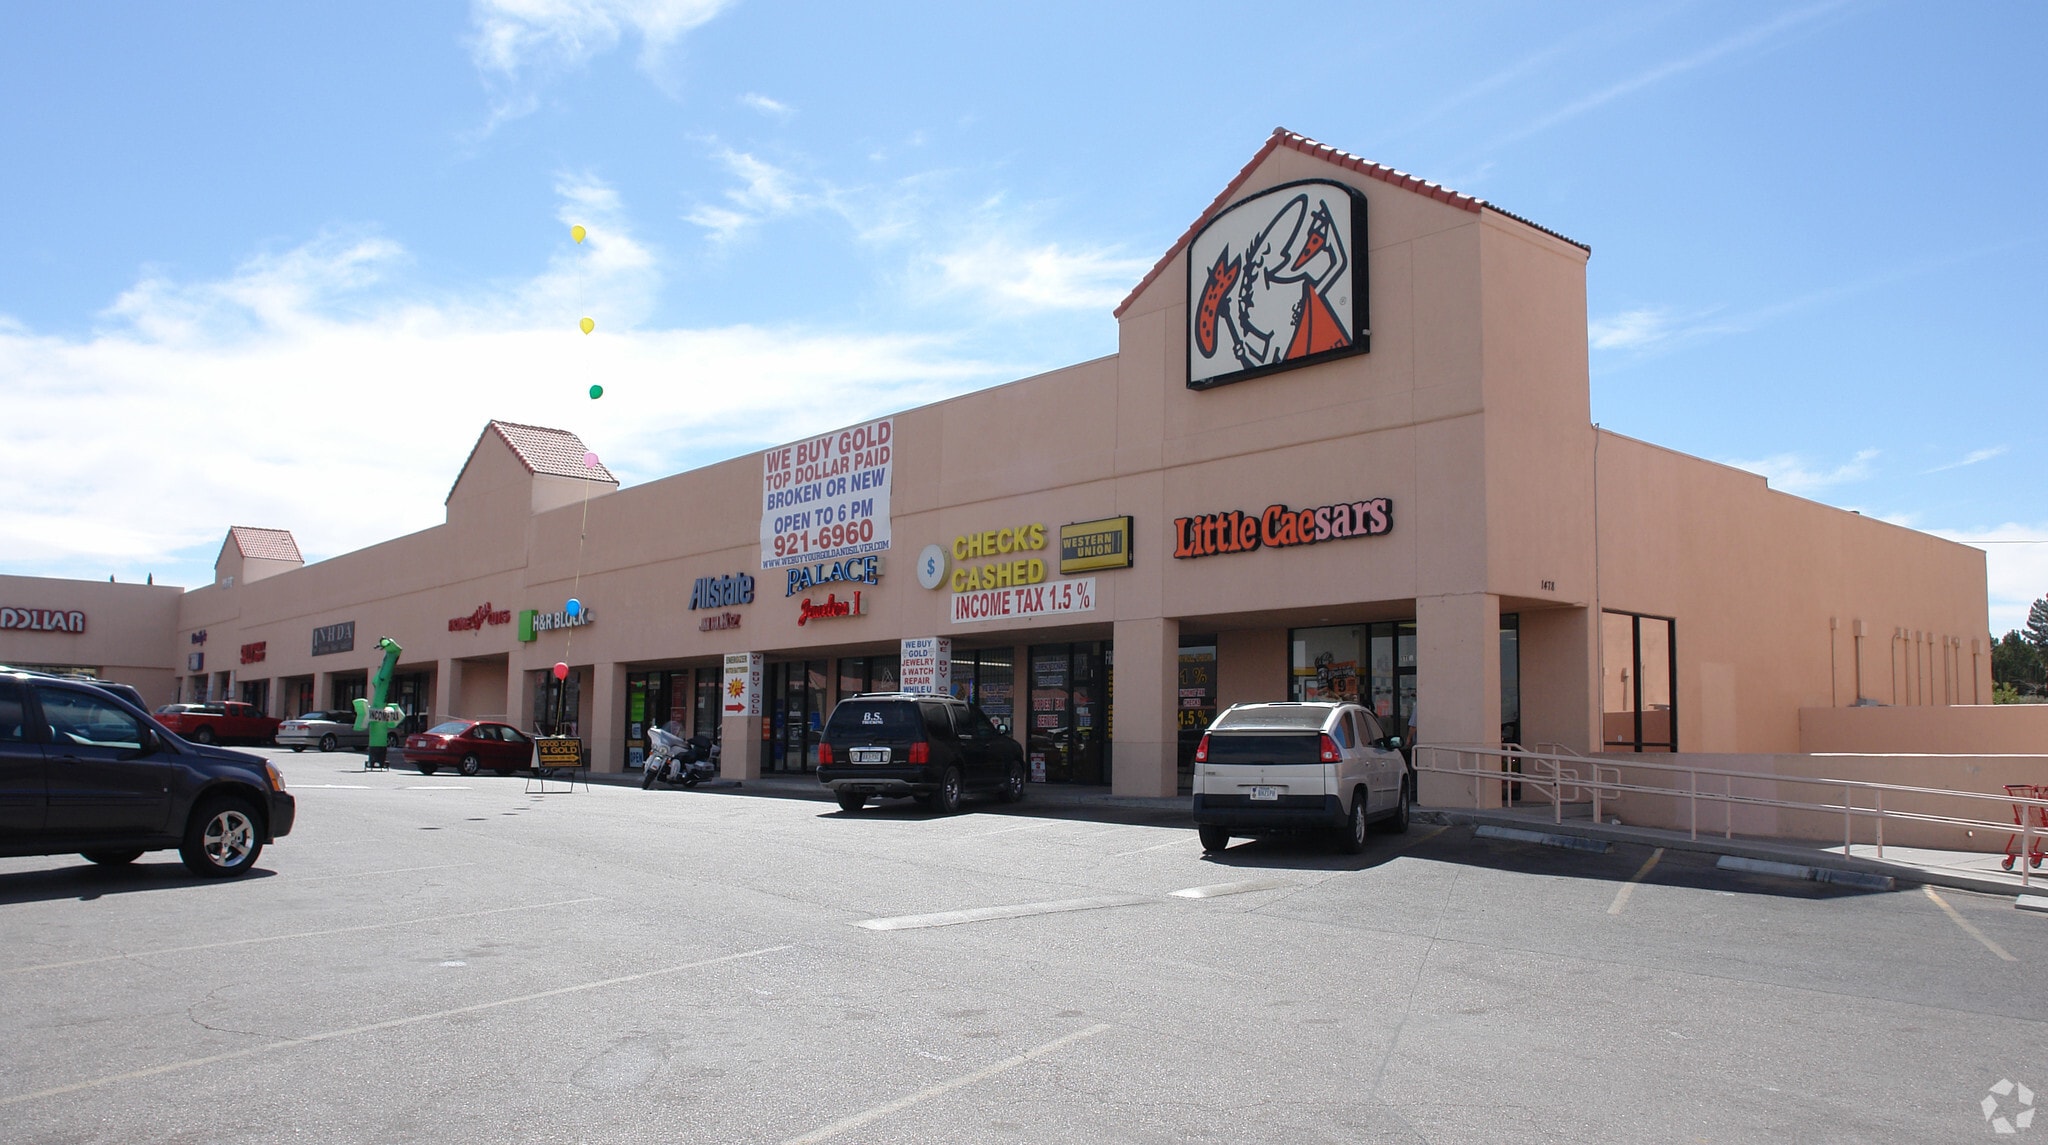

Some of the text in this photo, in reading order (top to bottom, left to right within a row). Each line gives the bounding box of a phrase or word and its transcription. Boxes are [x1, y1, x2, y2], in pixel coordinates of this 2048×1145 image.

[767, 421, 891, 473] WE BUY GOLD
[766, 446, 890, 491] TOP DOLLAR PAID
[767, 468, 885, 510] BROKEN OR NEW
[774, 498, 873, 534] OPEN TO 6 PM
[1174, 498, 1393, 559] Little Caesars
[774, 519, 873, 557] 921-6960
[952, 522, 1047, 560] CHECKS
[1063, 533, 1112, 549] WESTERN
[1077, 544, 1112, 557] UNION
[688, 572, 754, 610] Allstate
[785, 555, 878, 597] PALACE
[952, 558, 1046, 593] CASHED
[956, 581, 1090, 619] INCOME TAX 1.5 %
[0, 606, 84, 633] DOLLAR
[532, 613, 552, 631] H&R
[905, 640, 932, 648] WE BUY
[909, 649, 928, 657] GOLD
[902, 658, 934, 667] JEWELRY
[939, 660, 948, 678] BUY
[751, 654, 761, 714] WE BUY GOLD
[904, 677, 930, 685] REPAIR
[863, 712, 882, 721] B.S.
[1179, 710, 1208, 725] 1.5 %
